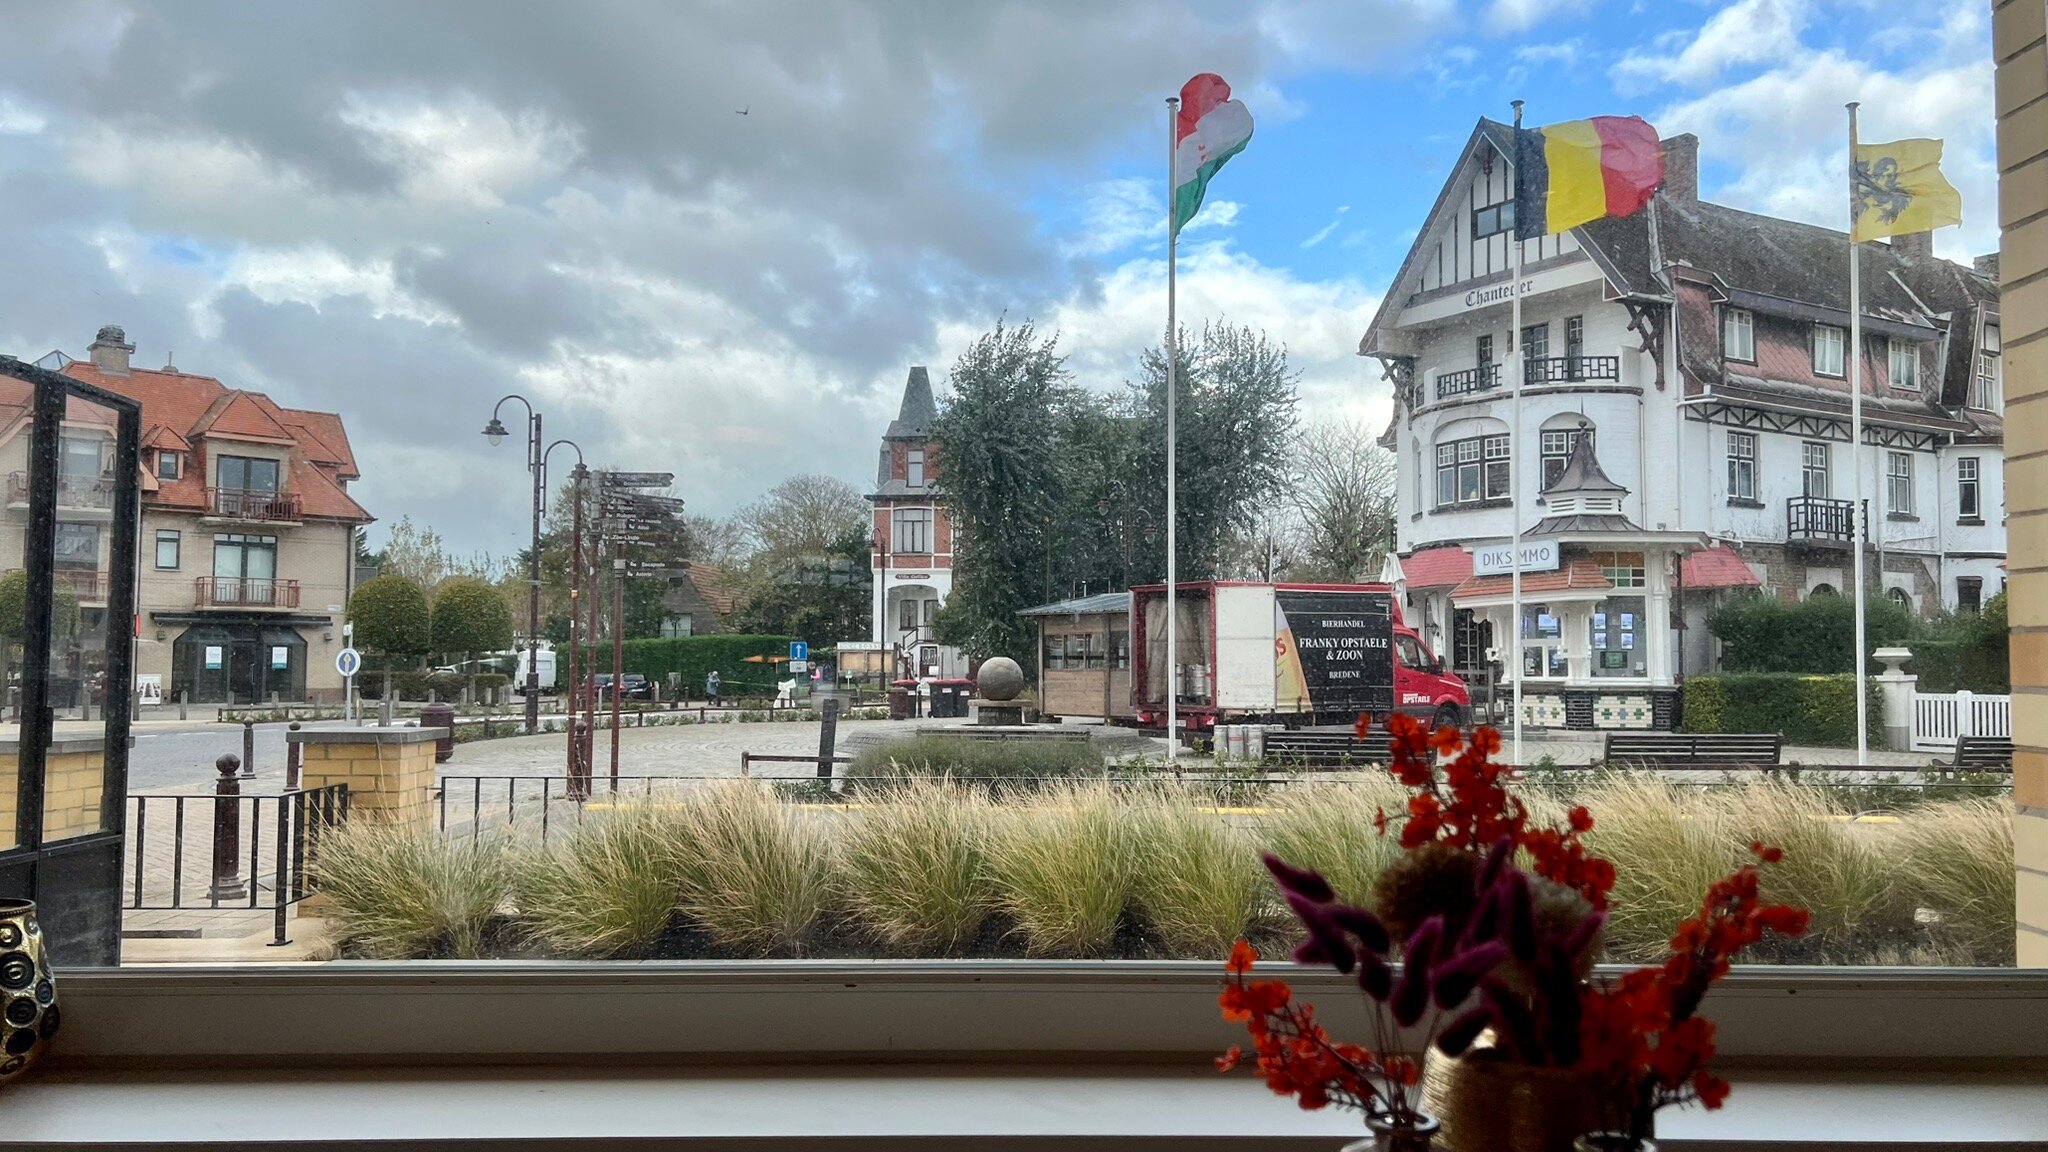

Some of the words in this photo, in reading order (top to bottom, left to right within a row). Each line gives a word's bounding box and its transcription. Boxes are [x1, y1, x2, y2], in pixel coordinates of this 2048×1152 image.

[1465, 280, 1533, 307] Chantecer
[1483, 547, 1550, 566] DIKSMMO
[1322, 620, 1366, 628] BIERHANDEL
[1299, 638, 1339, 648] FRANKY
[1340, 638, 1388, 648] OPSTAELE
[1326, 650, 1334, 660] &
[1336, 650, 1363, 660] ZOON
[1329, 671, 1361, 679] BREDENE
